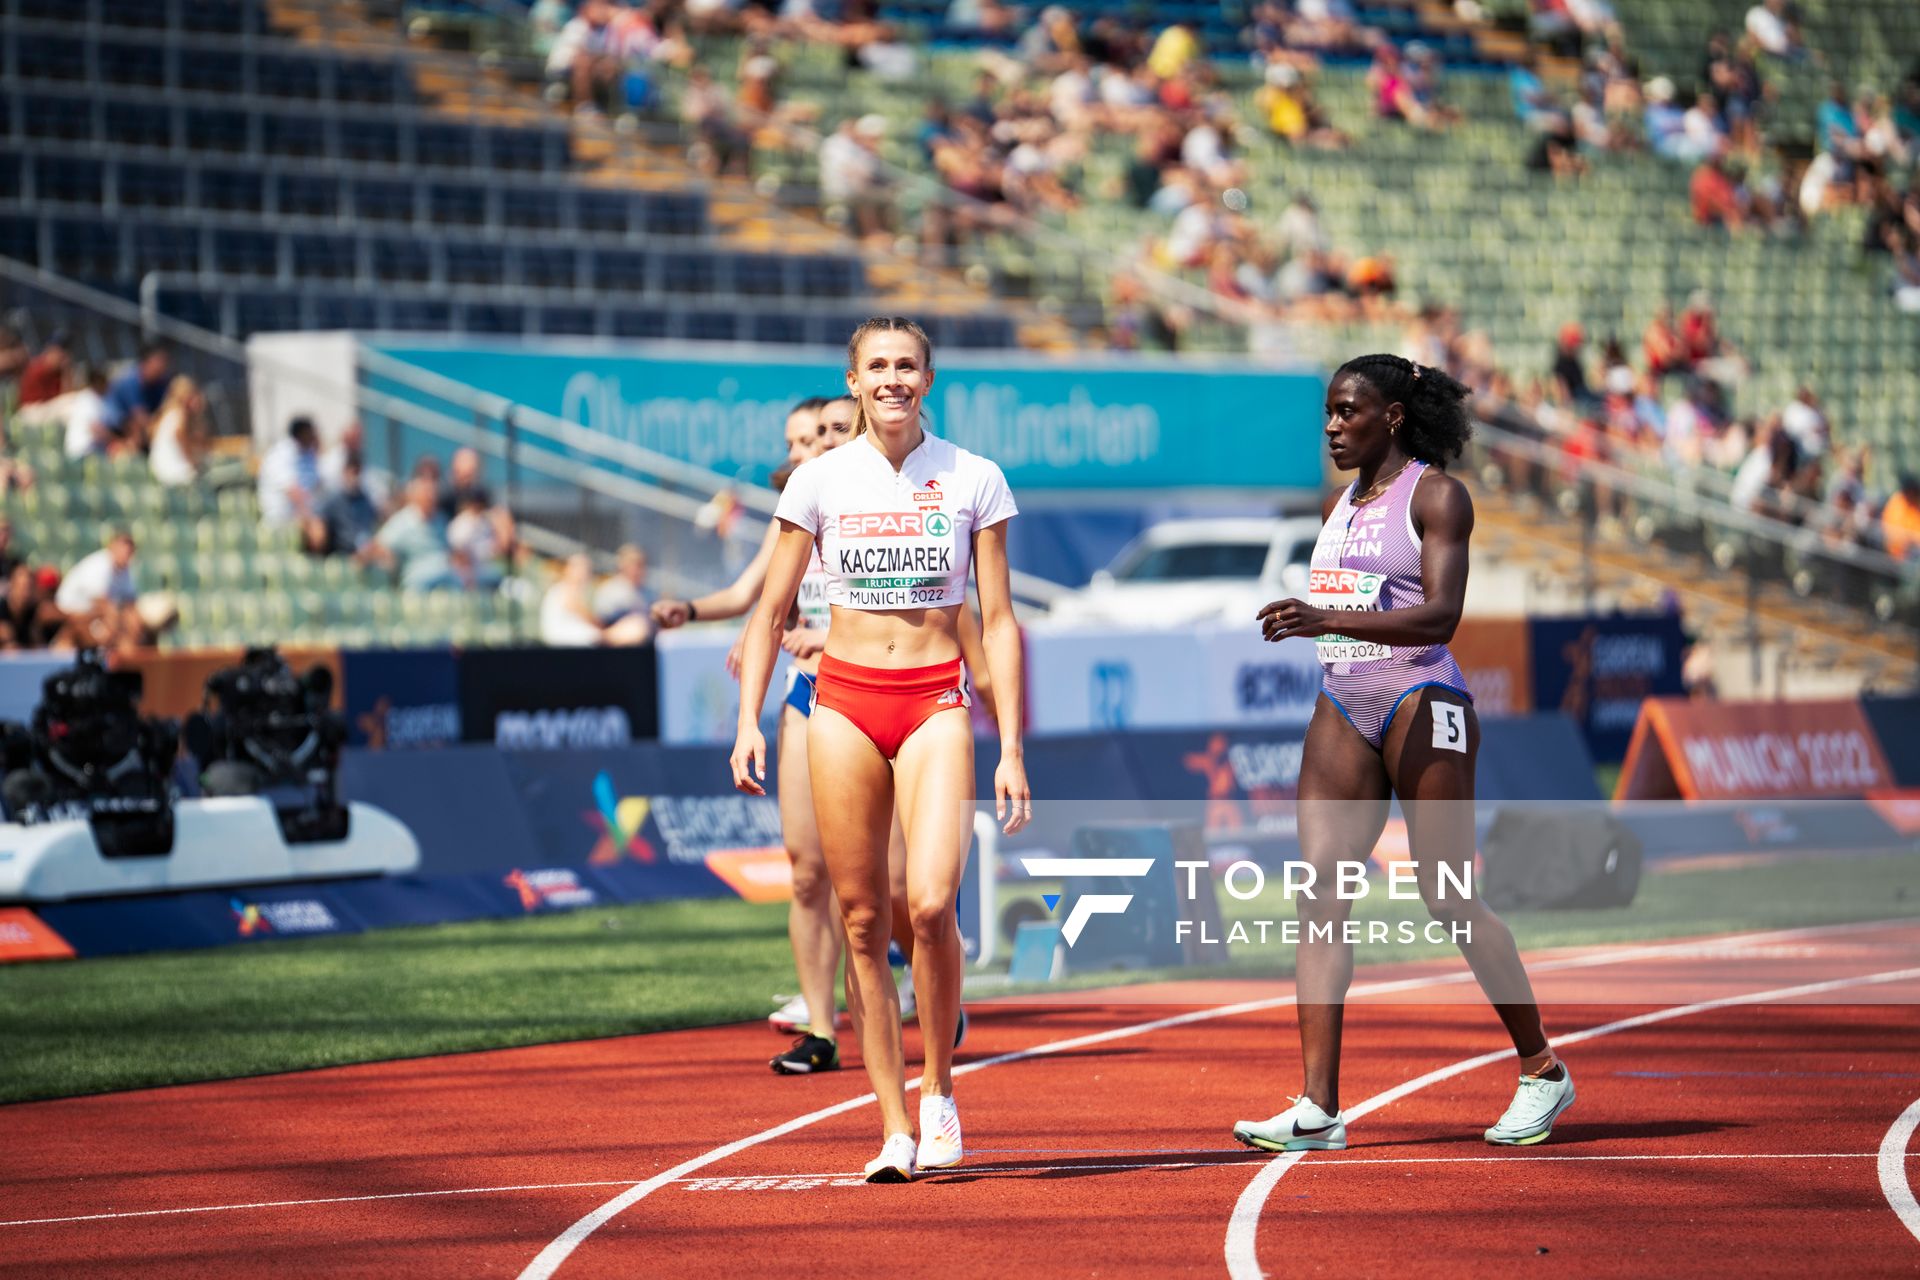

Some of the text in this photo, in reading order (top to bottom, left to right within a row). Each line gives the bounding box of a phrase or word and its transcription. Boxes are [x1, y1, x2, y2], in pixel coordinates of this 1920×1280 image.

[562, 371, 788, 469] Olympias
[841, 515, 921, 536] SPAR
[840, 547, 951, 573] KACZMAREK
[1315, 541, 1382, 560] RITAIN
[871, 579, 891, 588] RUN
[1311, 572, 1354, 591] SPAR
[801, 582, 827, 601] MA
[850, 589, 944, 605] MUNICH 2022
[1320, 644, 1384, 658] NICH 2022
[1446, 710, 1460, 743] 5
